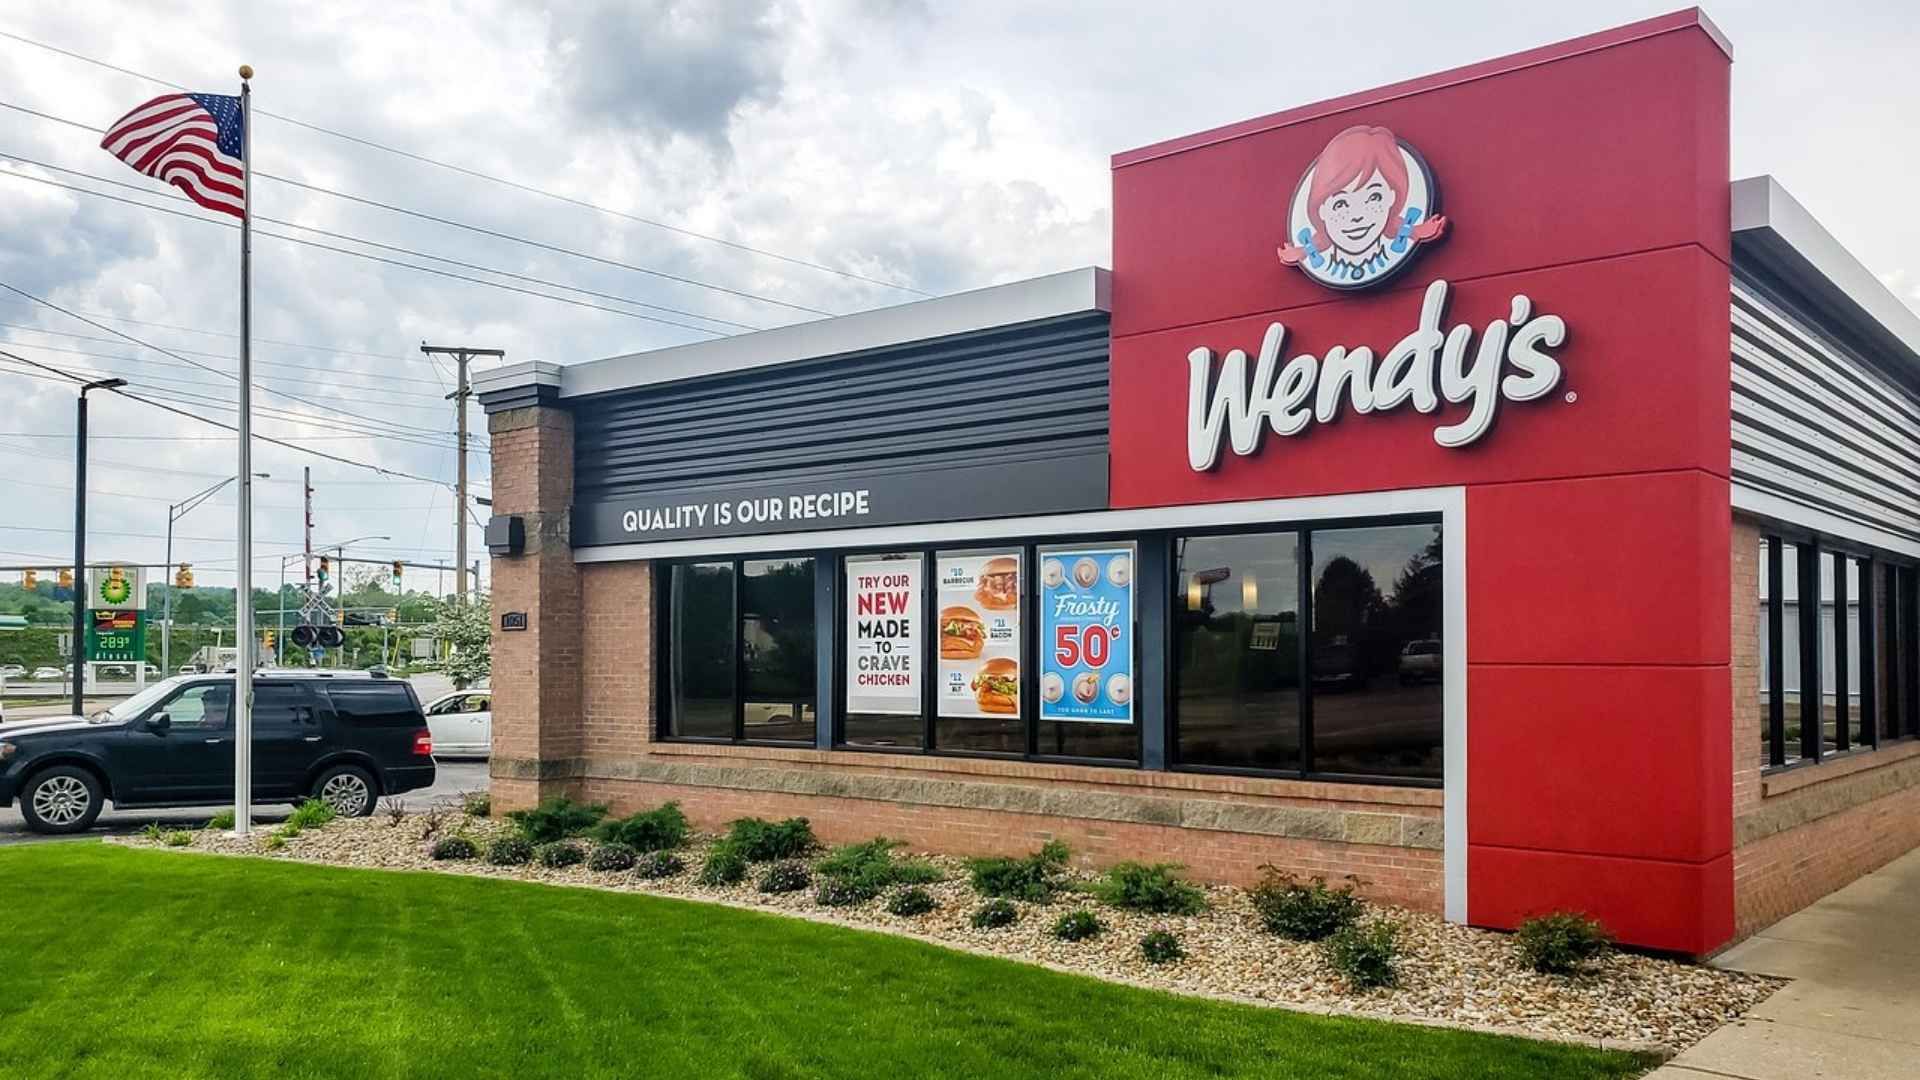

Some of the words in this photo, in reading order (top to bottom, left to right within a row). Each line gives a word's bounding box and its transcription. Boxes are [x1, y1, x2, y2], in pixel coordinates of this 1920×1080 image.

[1188, 279, 1565, 471] Wendy's
[622, 504, 709, 532] QUALITY
[714, 502, 732, 526] IS
[737, 498, 783, 524] OUR
[789, 490, 869, 520] RECIPE
[857, 576, 880, 589] TRY
[882, 574, 910, 588] OUR
[857, 592, 910, 616] NEW
[1054, 593, 1119, 626] Frosty
[857, 619, 910, 639] MADE
[874, 641, 892, 654] TO
[857, 655, 910, 671] CRAVE
[857, 673, 910, 686] CHICKEN
